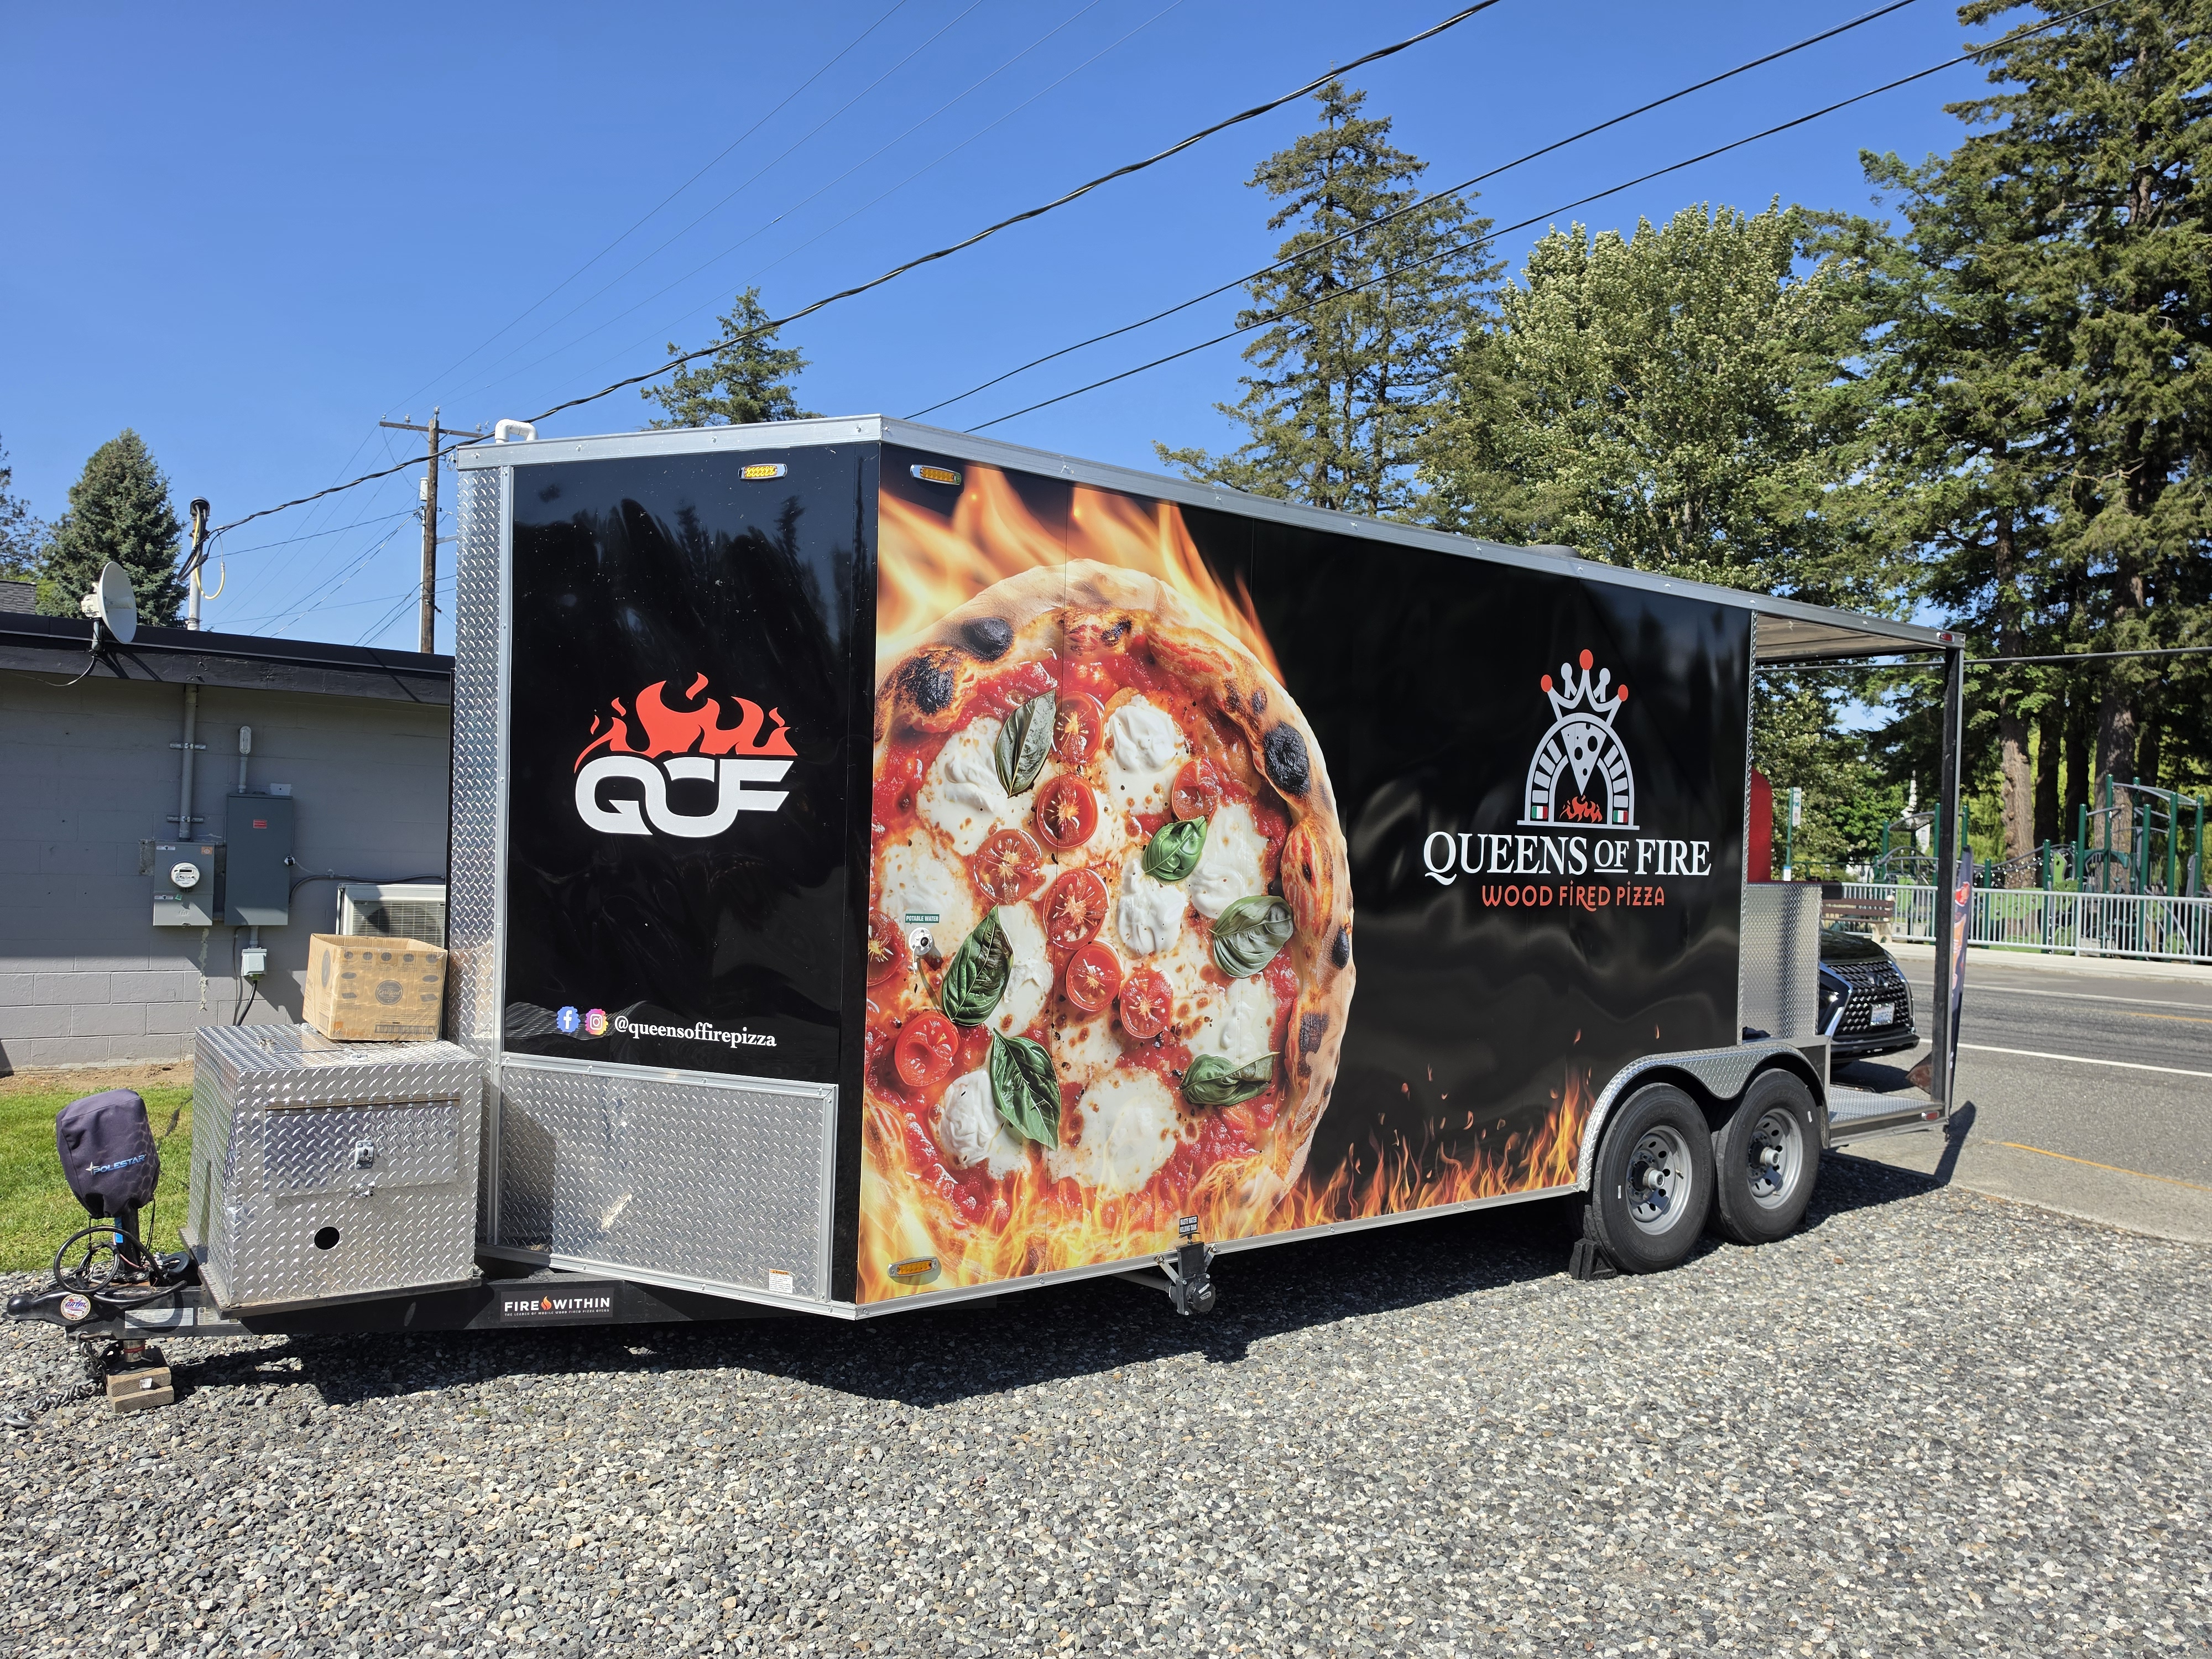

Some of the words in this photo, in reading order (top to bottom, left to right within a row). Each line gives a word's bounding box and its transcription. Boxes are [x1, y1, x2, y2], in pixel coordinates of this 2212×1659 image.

[1423, 831, 1588, 885] QUEENS
[1594, 839, 1629, 868] OF
[1635, 838, 1712, 876] FIRE
[1482, 885, 1553, 907] WOOD
[378, 989, 401, 997] Certified
[614, 1015, 777, 1048] @queensoffirepizza
[93, 1154, 146, 1175] POLESTAR
[504, 1300, 539, 1312] FIRE
[553, 1297, 610, 1310] WITHIN
